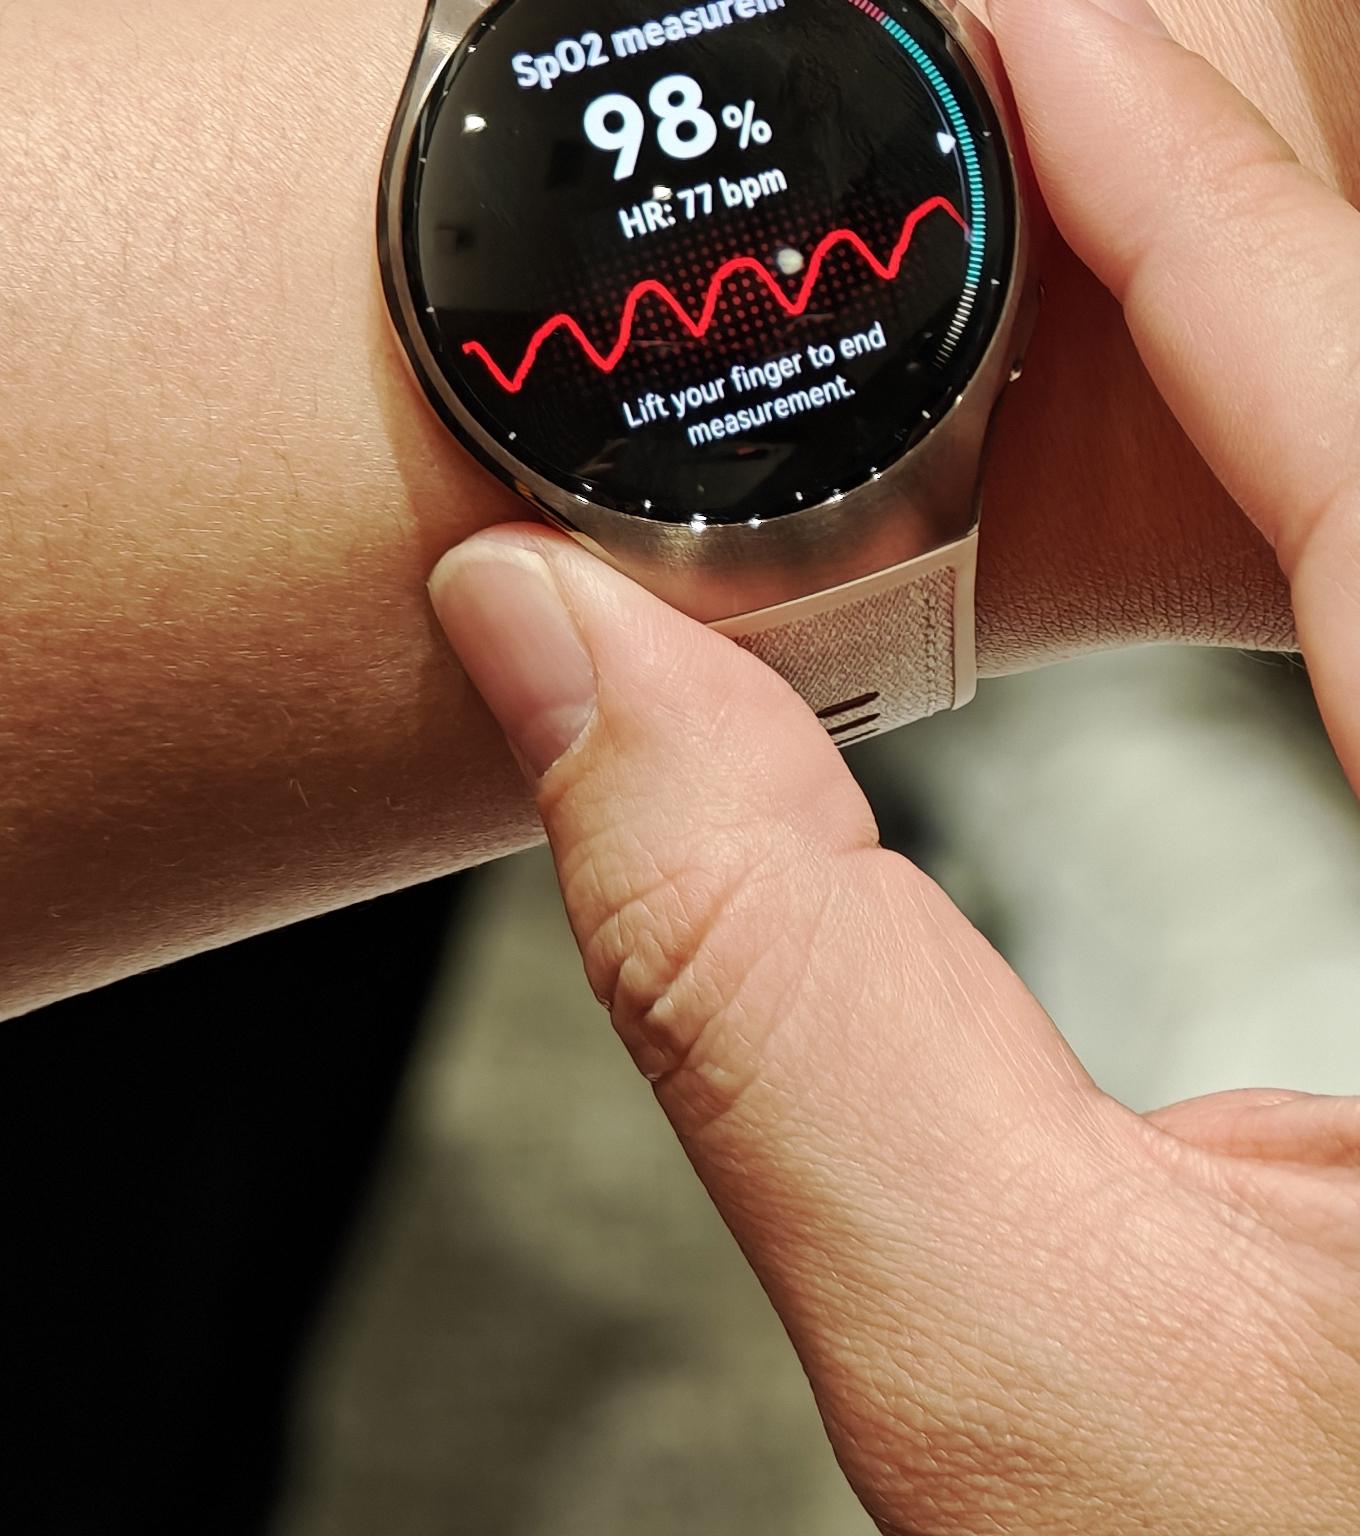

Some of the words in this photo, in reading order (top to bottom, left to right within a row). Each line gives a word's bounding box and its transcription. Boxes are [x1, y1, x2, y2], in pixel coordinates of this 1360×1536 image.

[511, 31, 610, 90] SpO2
[583, 74, 773, 181] 98%
[618, 200, 676, 239] HR:
[676, 183, 712, 220] 77
[719, 168, 788, 208] bpm
[622, 392, 670, 428] Lift
[670, 378, 726, 418] your
[730, 352, 803, 393] finger
[807, 345, 835, 369] to
[840, 320, 887, 358] end
[687, 374, 856, 447] measurement.
